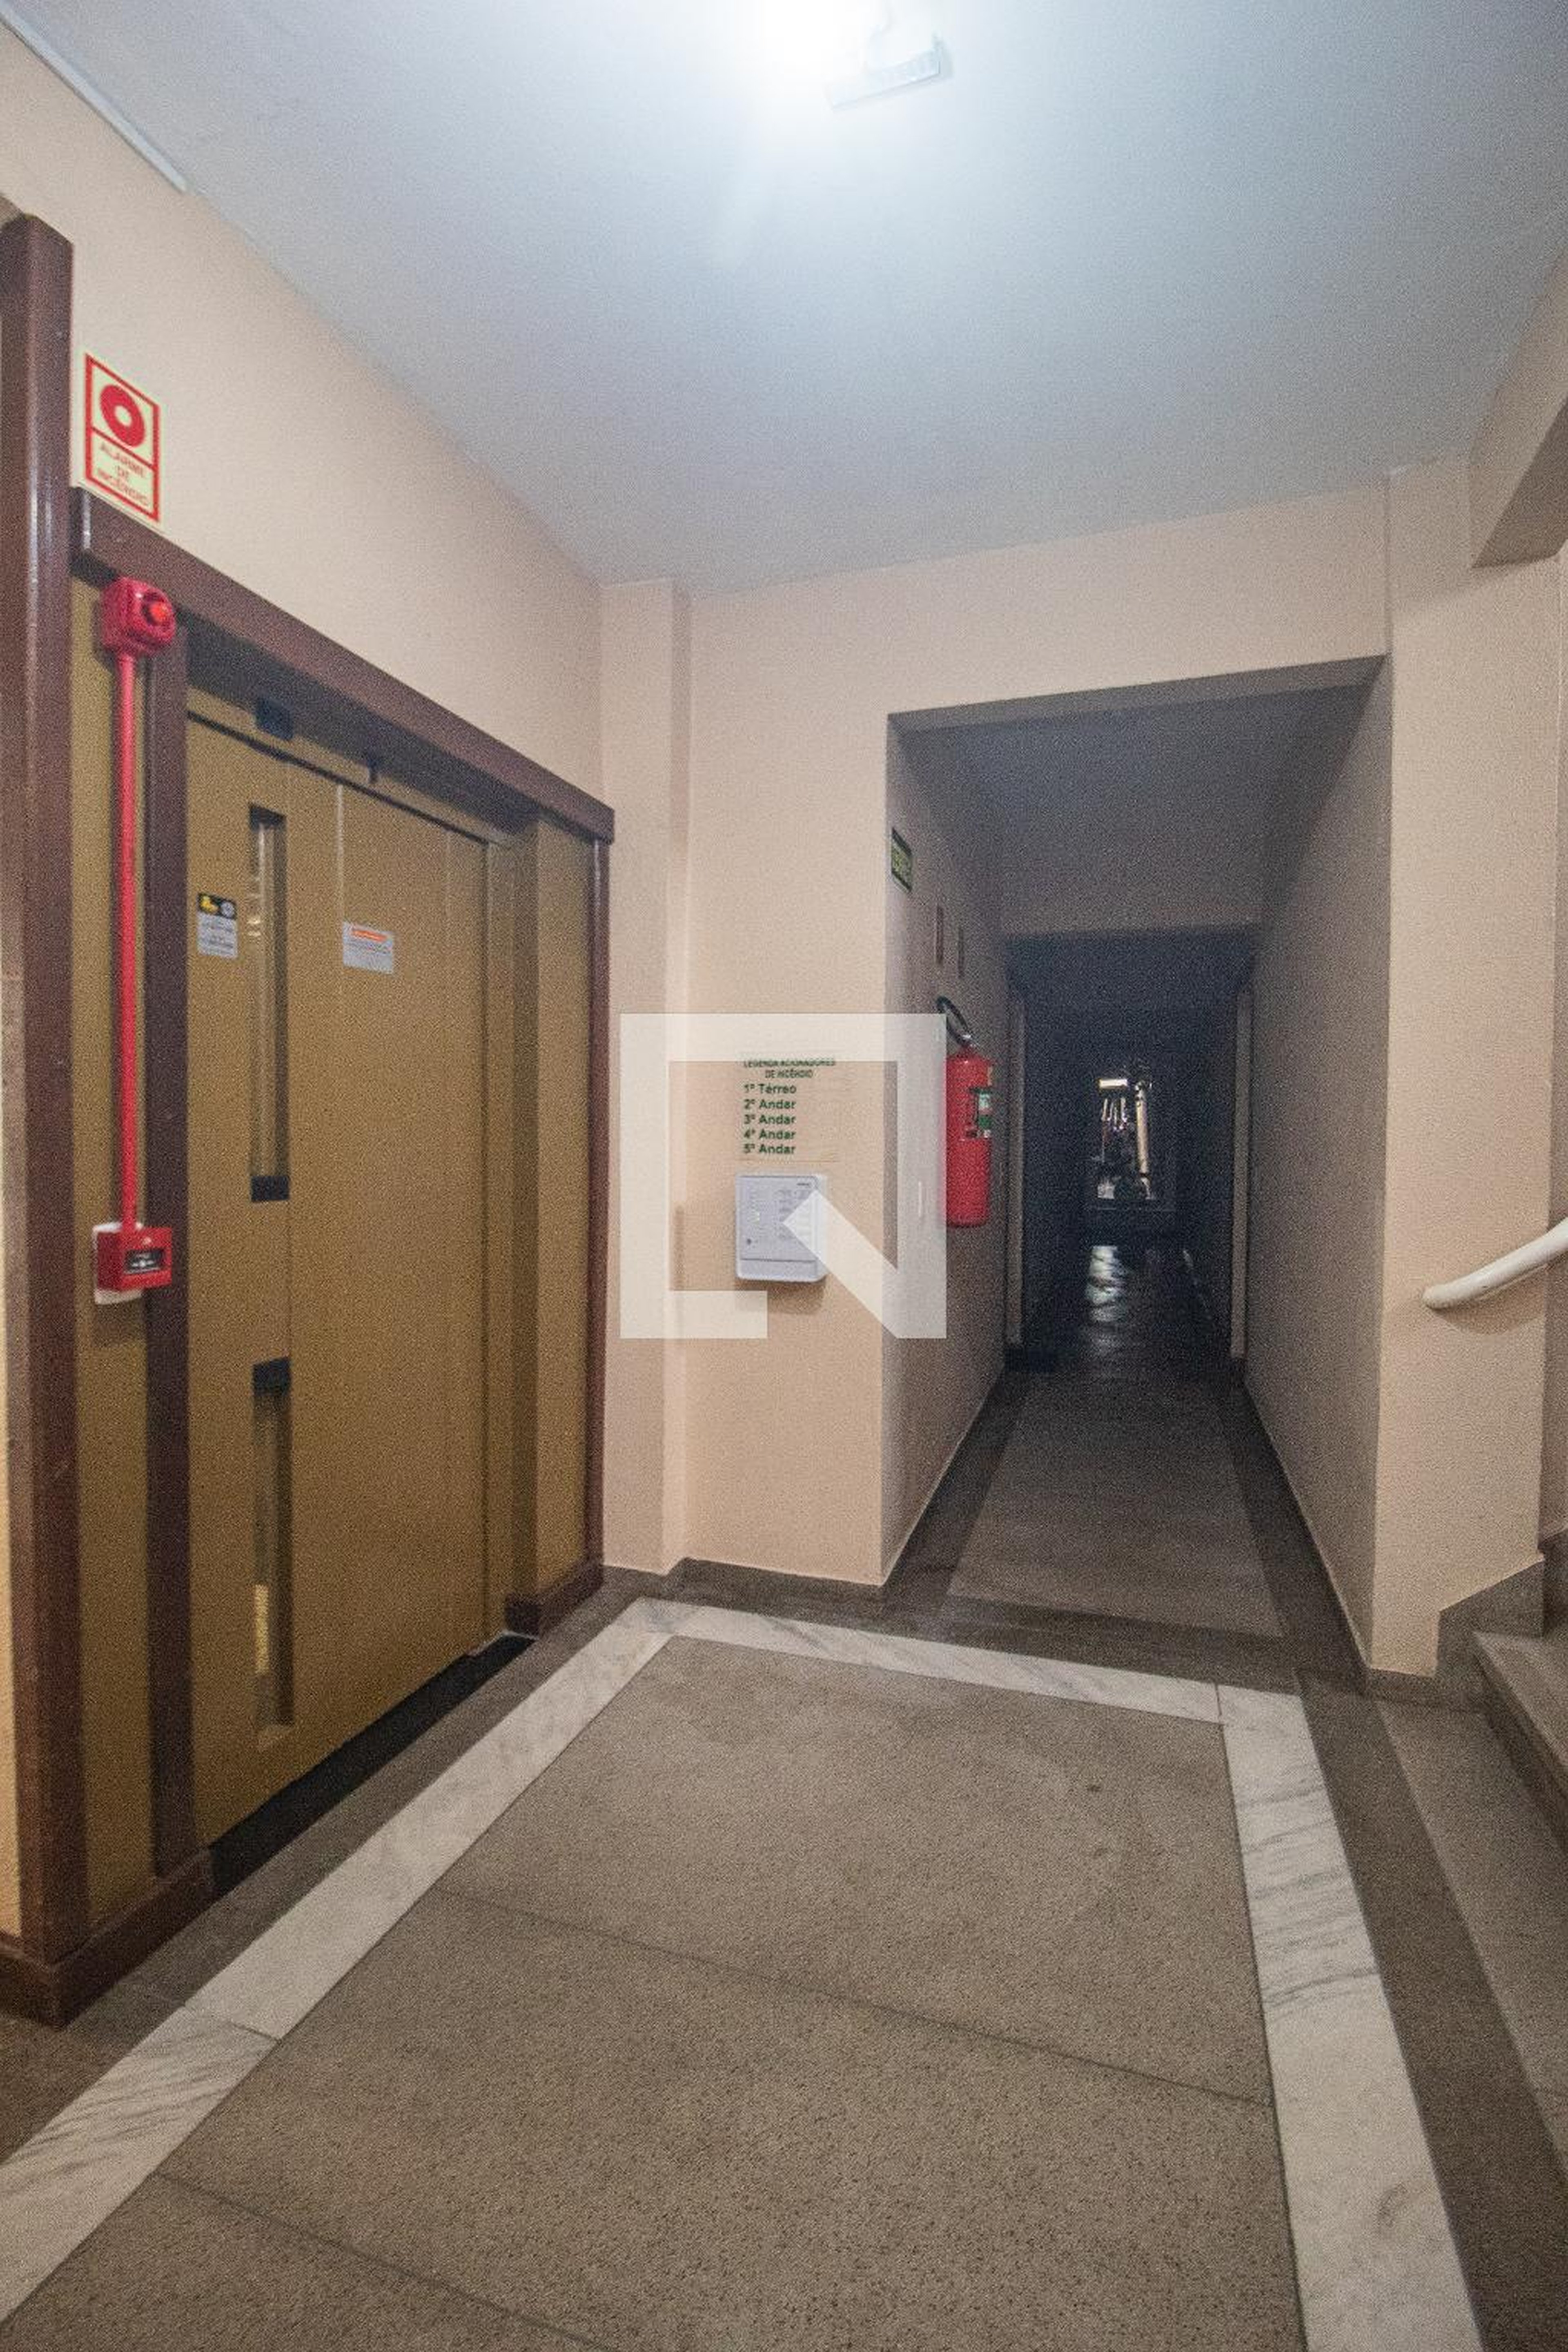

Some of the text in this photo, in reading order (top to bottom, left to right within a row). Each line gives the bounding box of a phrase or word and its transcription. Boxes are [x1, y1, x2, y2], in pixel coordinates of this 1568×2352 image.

[765, 1069, 775, 1078] DE
[758, 1082, 797, 1094] Térreo
[759, 1099, 796, 1109] Andar
[759, 1114, 796, 1125] Andar
[759, 1129, 796, 1140] Andar
[759, 1144, 796, 1154] Andar
